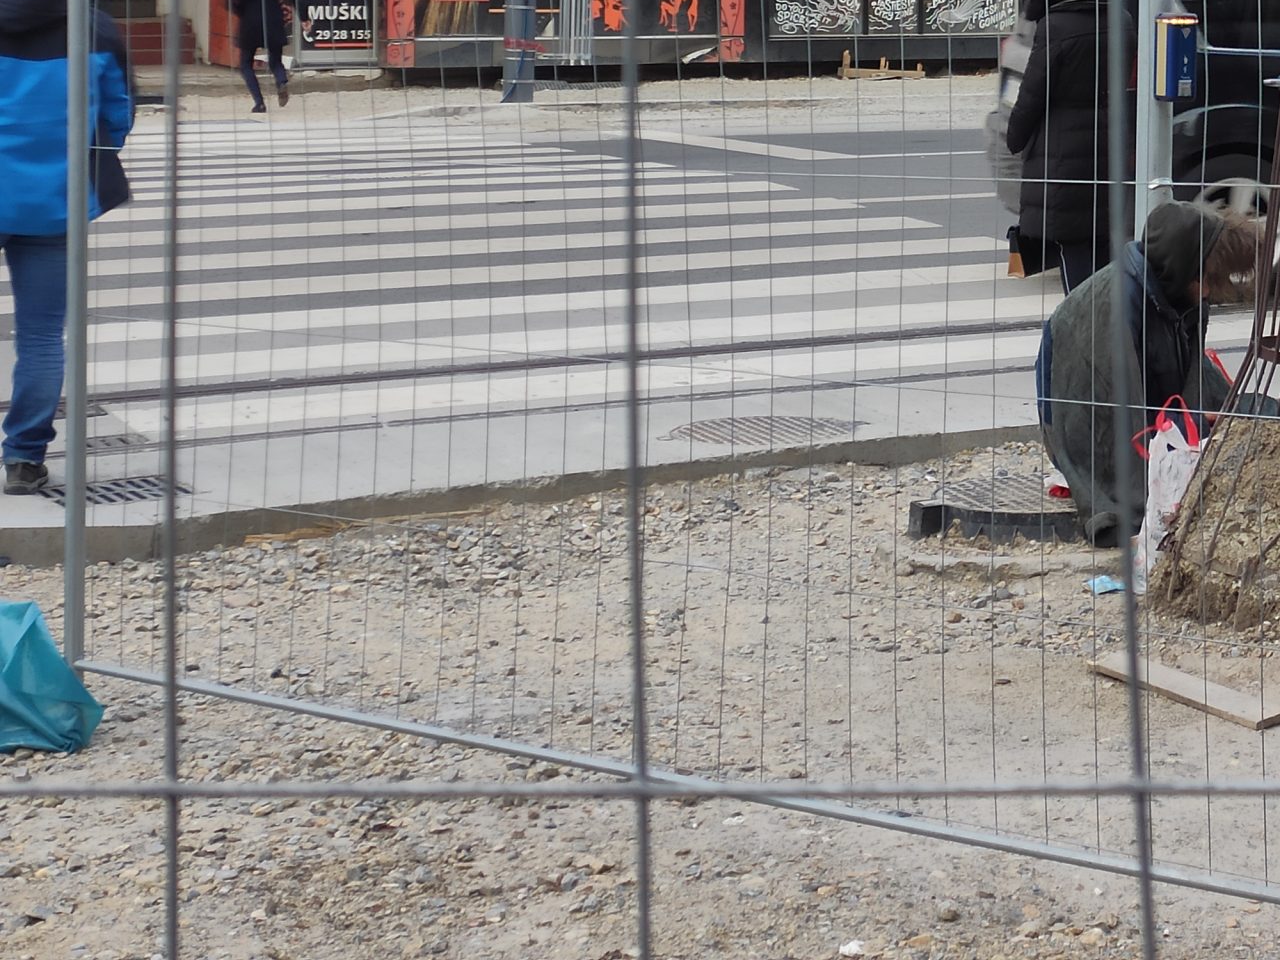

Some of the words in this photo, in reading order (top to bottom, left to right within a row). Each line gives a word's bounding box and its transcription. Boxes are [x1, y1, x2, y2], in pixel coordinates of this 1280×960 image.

[308, 3, 367, 20] MUŠKI
[315, 30, 331, 40] 29
[333, 30, 348, 40] 28
[351, 30, 371, 40] 155
